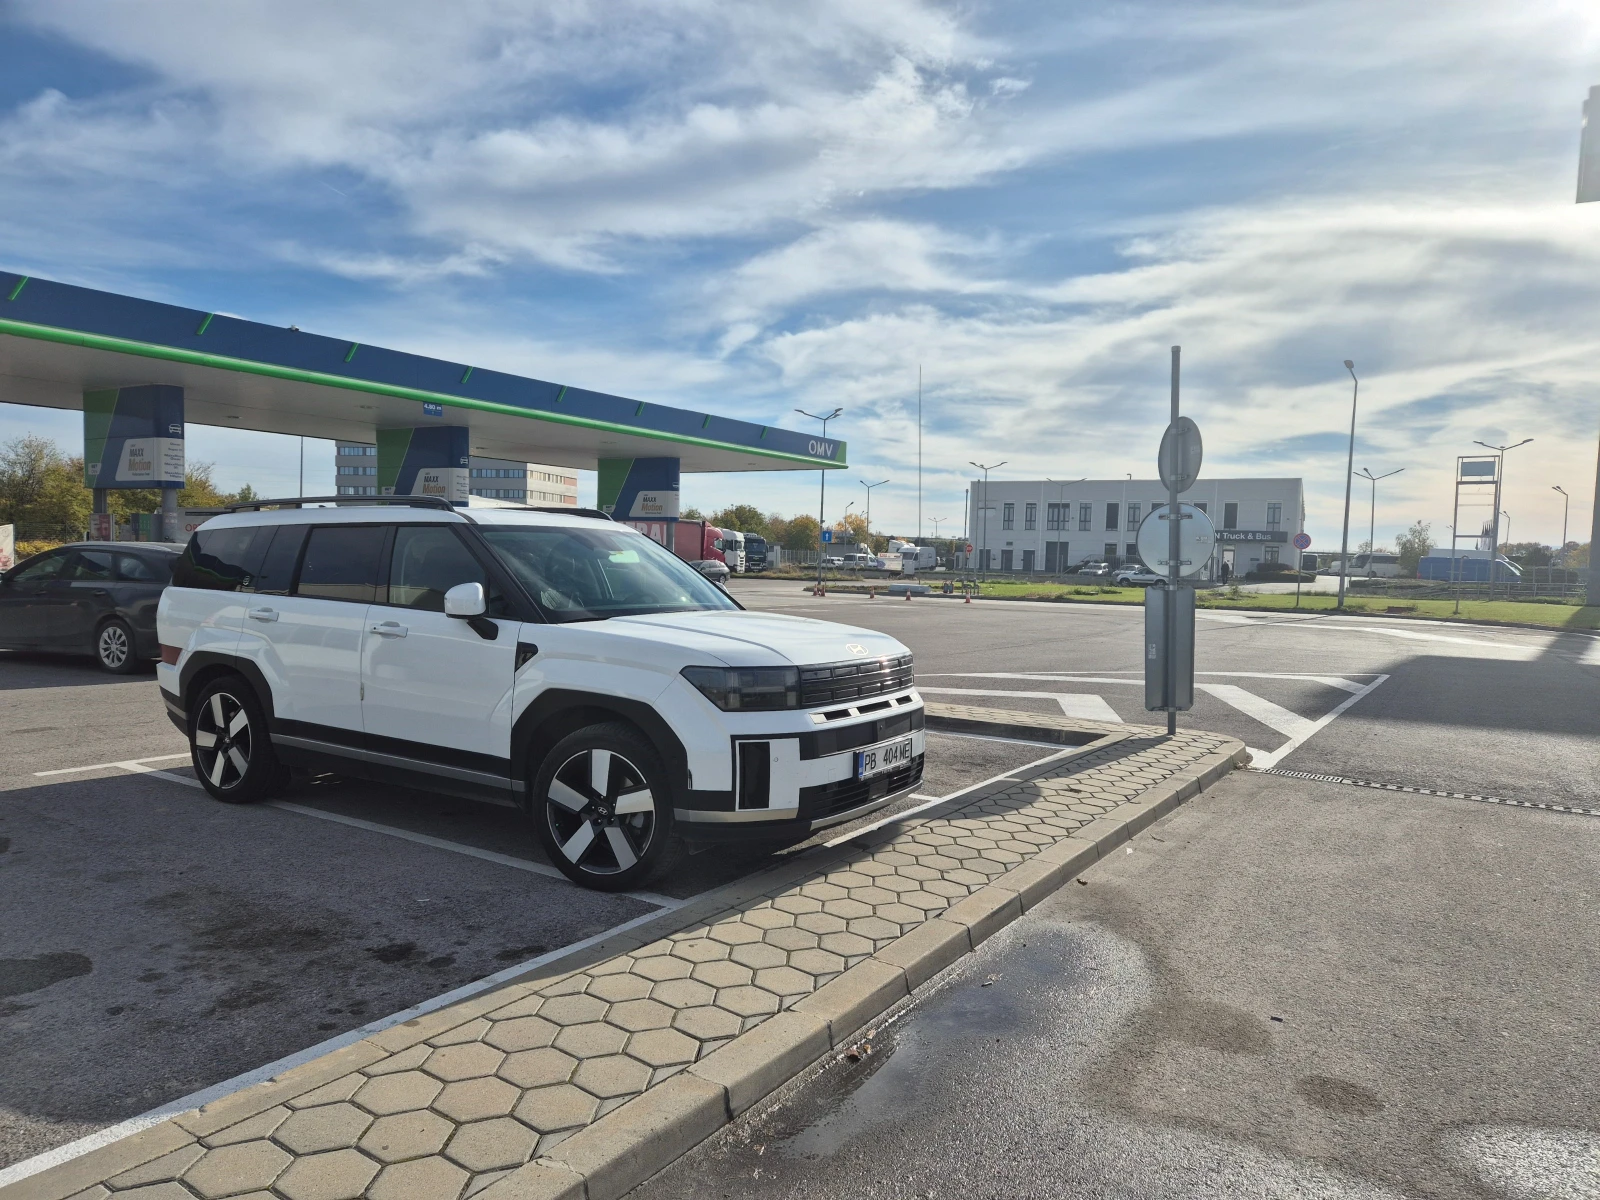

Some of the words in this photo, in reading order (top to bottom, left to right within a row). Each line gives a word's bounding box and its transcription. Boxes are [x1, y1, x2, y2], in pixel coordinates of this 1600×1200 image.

[130, 448, 144, 457] MAXX
[808, 440, 833, 457] OMV
[128, 458, 151, 471] Motion
[423, 483, 445, 493] Motion
[641, 503, 663, 511] Motion
[865, 753, 876, 771] PB
[883, 746, 898, 765] 404
